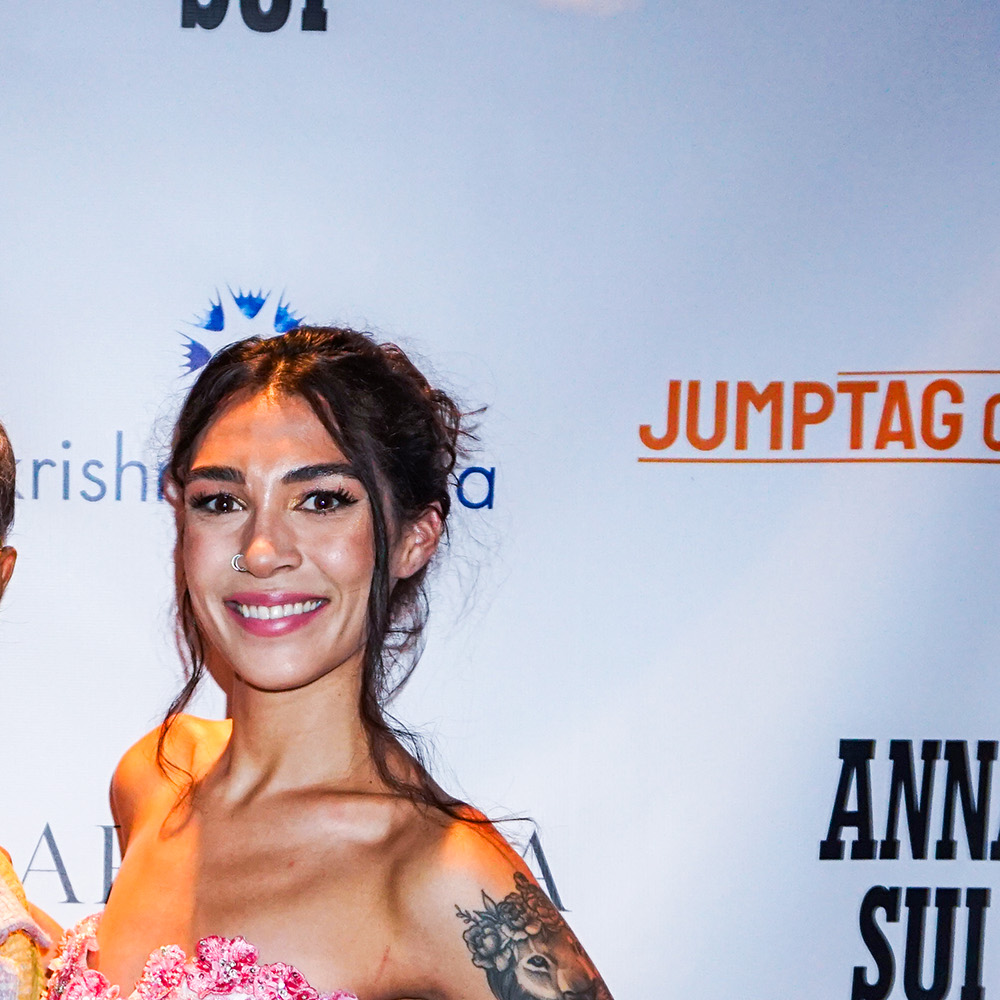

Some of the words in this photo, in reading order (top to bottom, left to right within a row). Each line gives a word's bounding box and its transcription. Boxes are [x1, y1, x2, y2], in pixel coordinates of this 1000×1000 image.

[638, 378, 965, 452] JUMPTAG
[15, 430, 163, 502] rish
[818, 738, 1000, 861] ANN
